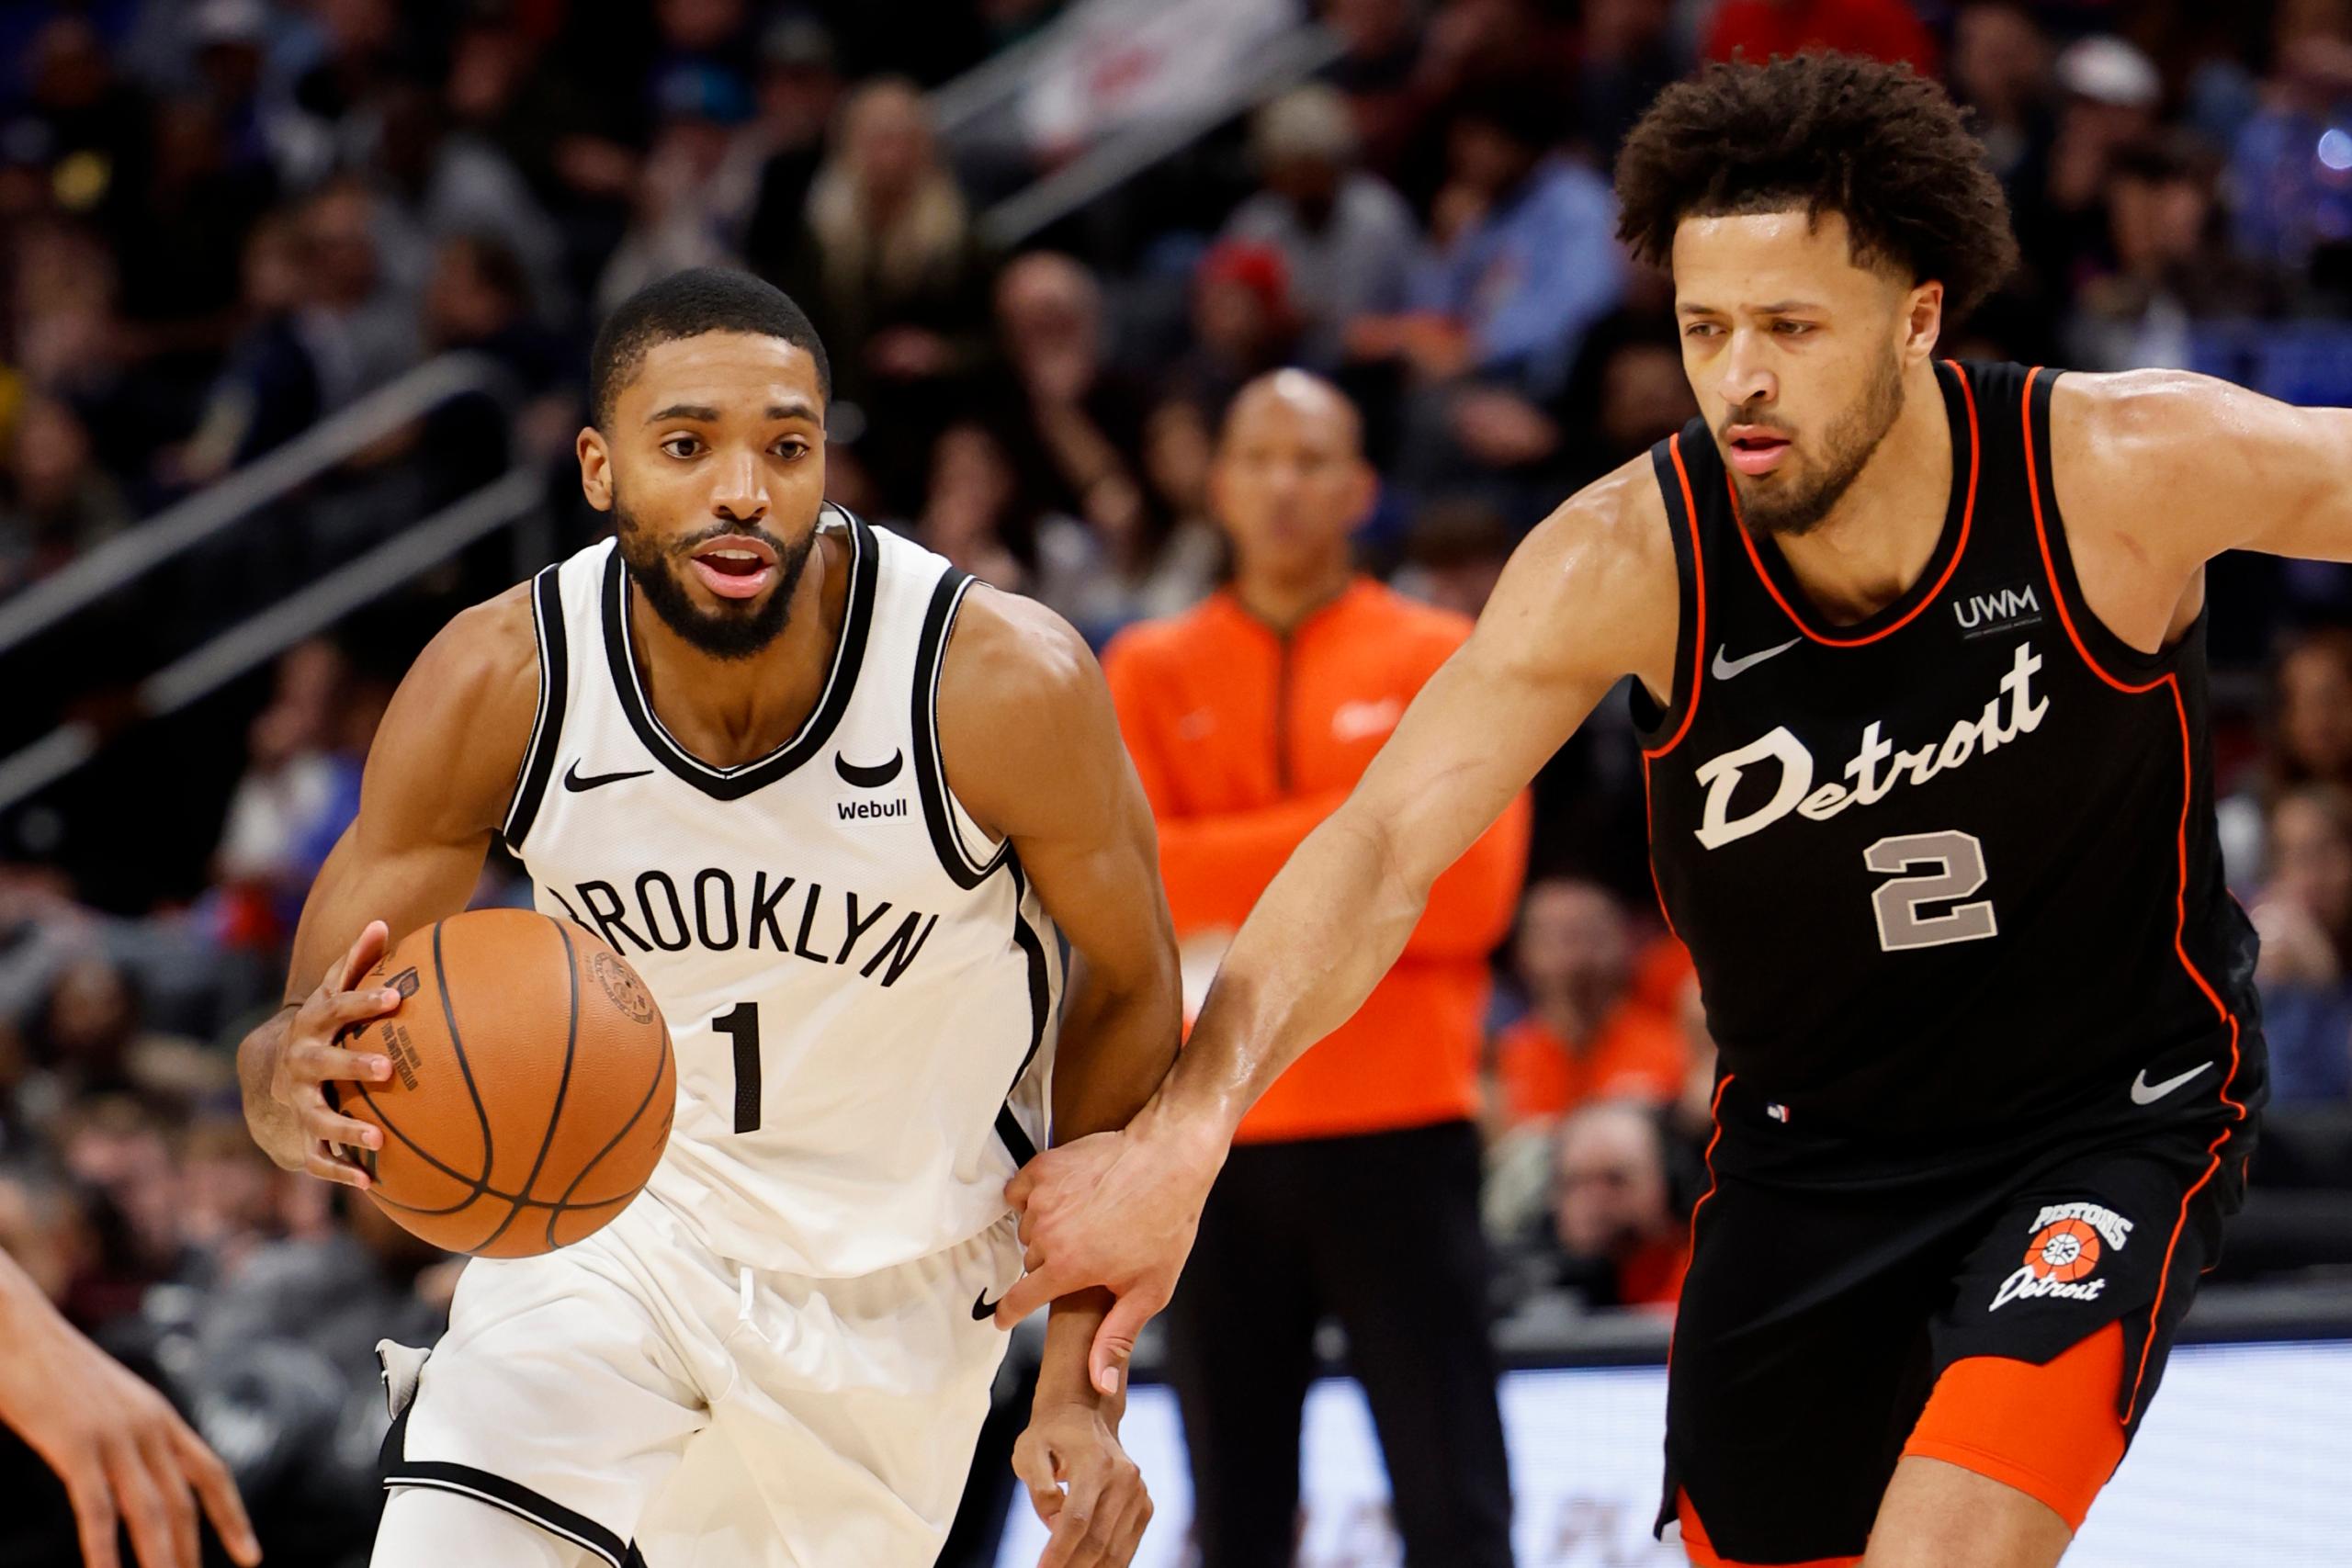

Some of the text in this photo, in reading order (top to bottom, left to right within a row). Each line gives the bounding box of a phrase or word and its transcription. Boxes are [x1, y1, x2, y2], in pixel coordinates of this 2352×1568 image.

[1953, 584, 2040, 628] UWM
[1694, 642, 2050, 851] Detroit
[837, 798, 907, 820] Webull
[1863, 829, 1997, 952] 2
[712, 1001, 762, 1134] 1
[2028, 1201, 2134, 1251] PISTONS
[1988, 1264, 2106, 1313] Detroit
